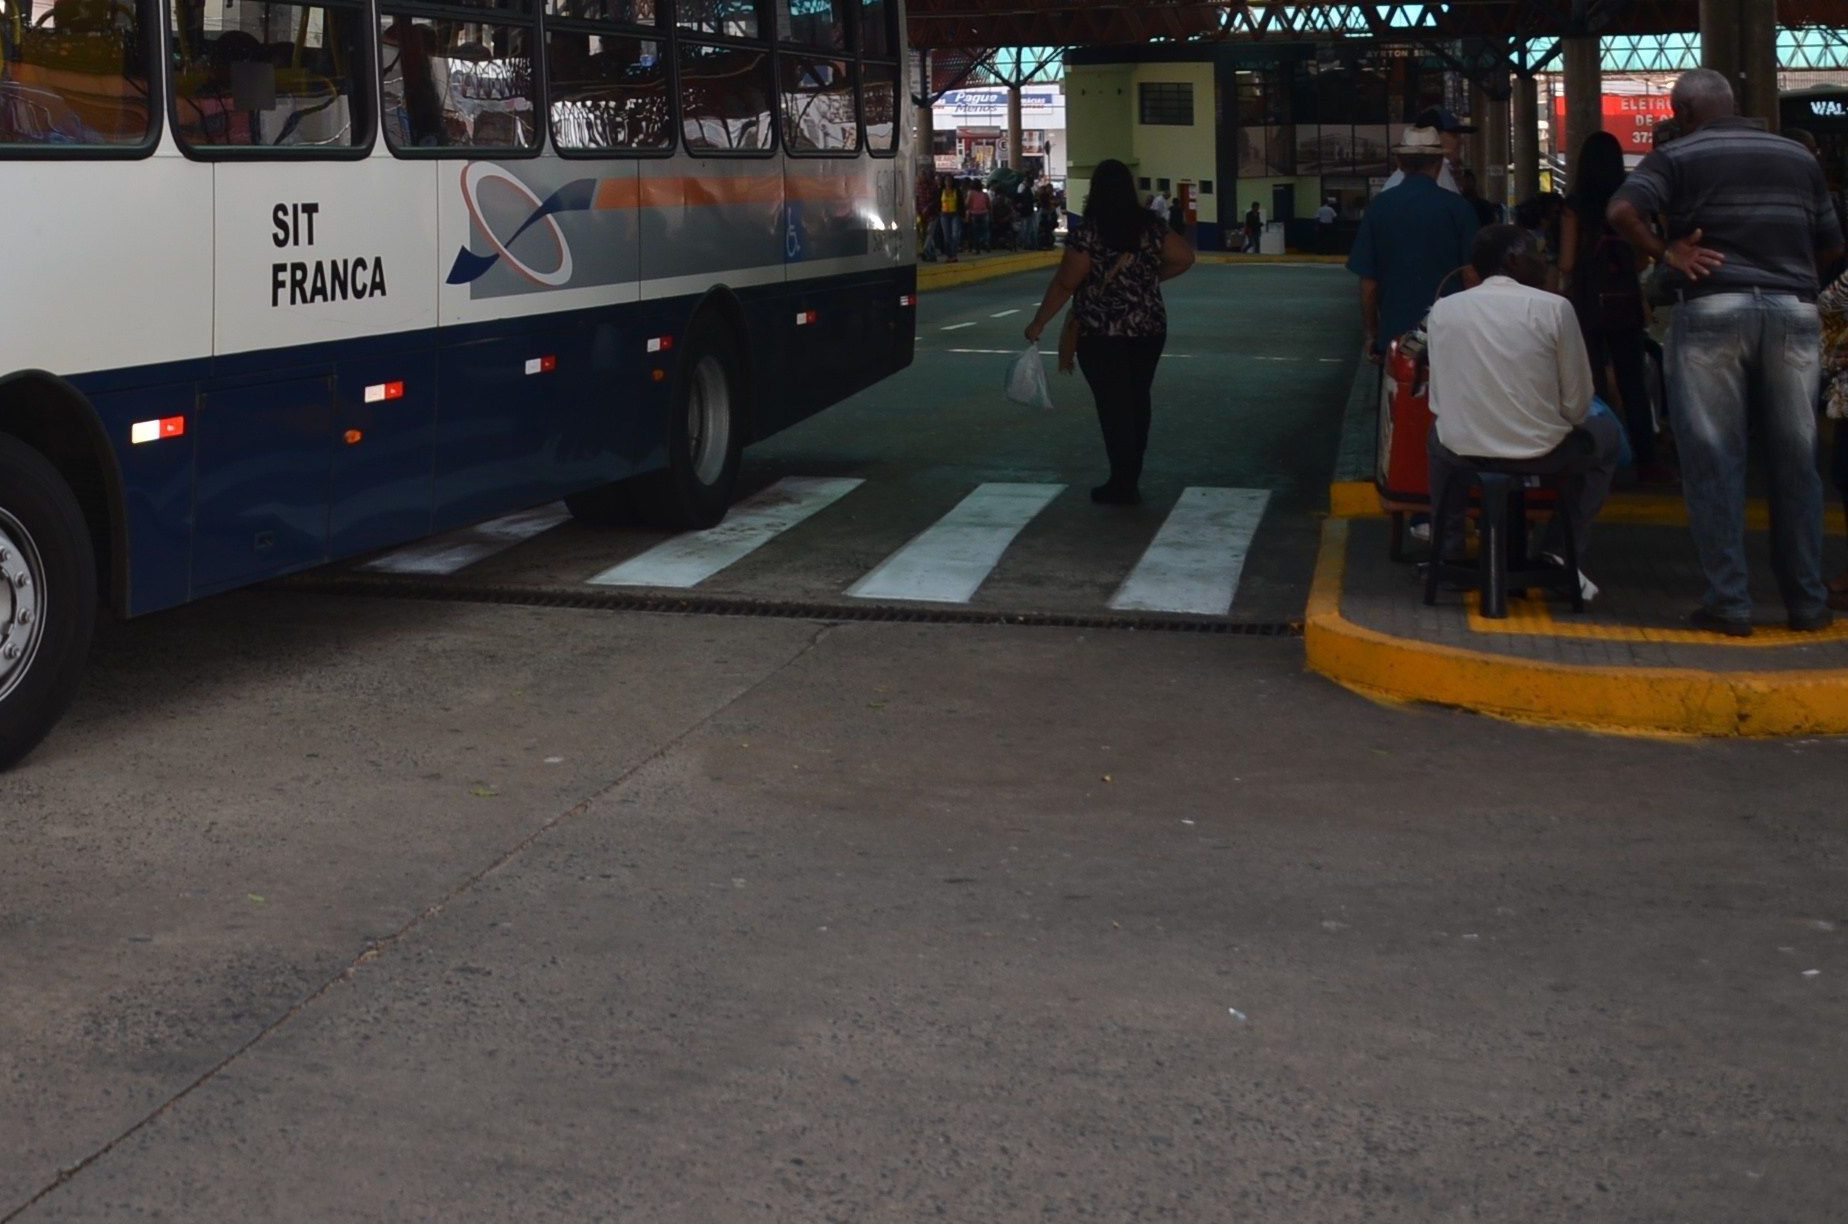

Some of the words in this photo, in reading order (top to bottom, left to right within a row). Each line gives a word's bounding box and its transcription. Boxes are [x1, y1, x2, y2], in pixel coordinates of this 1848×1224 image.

[954, 91, 998, 104] Pague
[954, 103, 998, 113] Menos
[1635, 113, 1653, 127] DE
[272, 202, 319, 248] SIT
[272, 256, 387, 307] FRANCA
